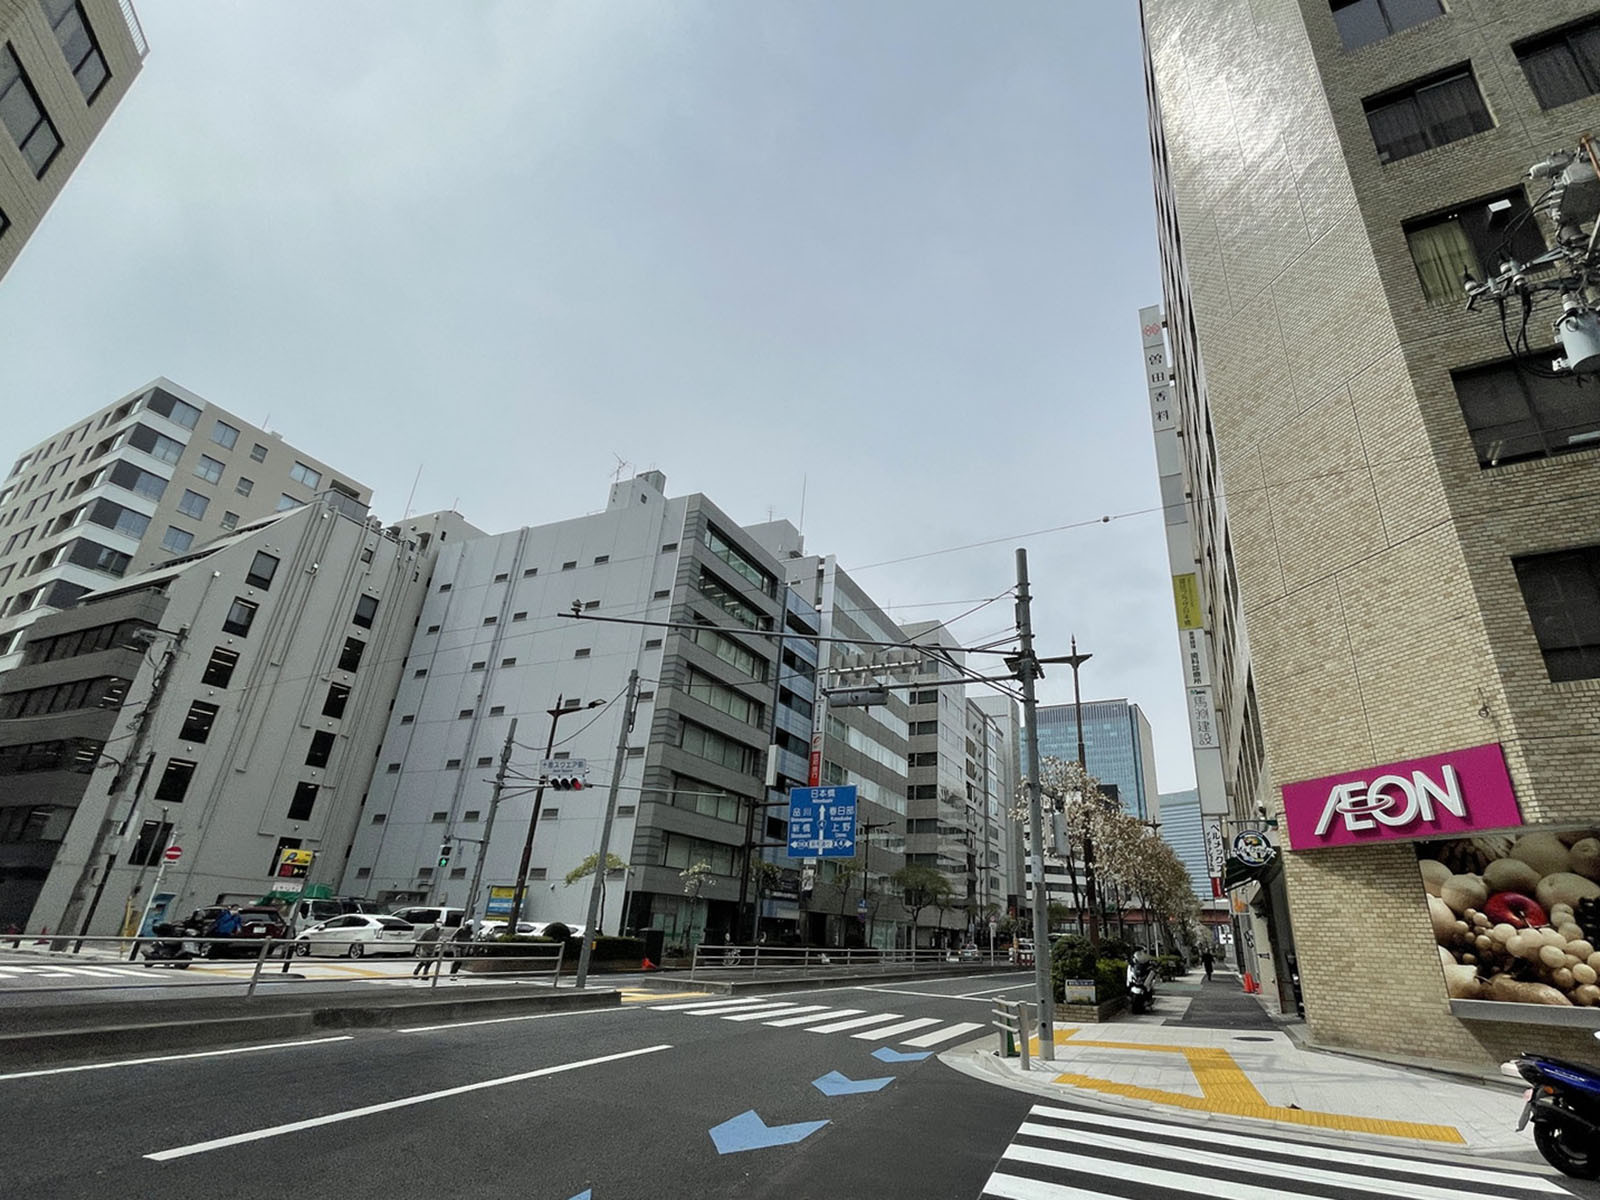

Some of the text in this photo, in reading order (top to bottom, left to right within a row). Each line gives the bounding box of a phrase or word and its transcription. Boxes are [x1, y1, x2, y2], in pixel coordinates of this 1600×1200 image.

[811, 789, 835, 798] 日本橋
[793, 807, 811, 816] 品川
[829, 806, 854, 815] 春日部
[792, 823, 810, 832] 新橋
[832, 822, 850, 832] 上野
